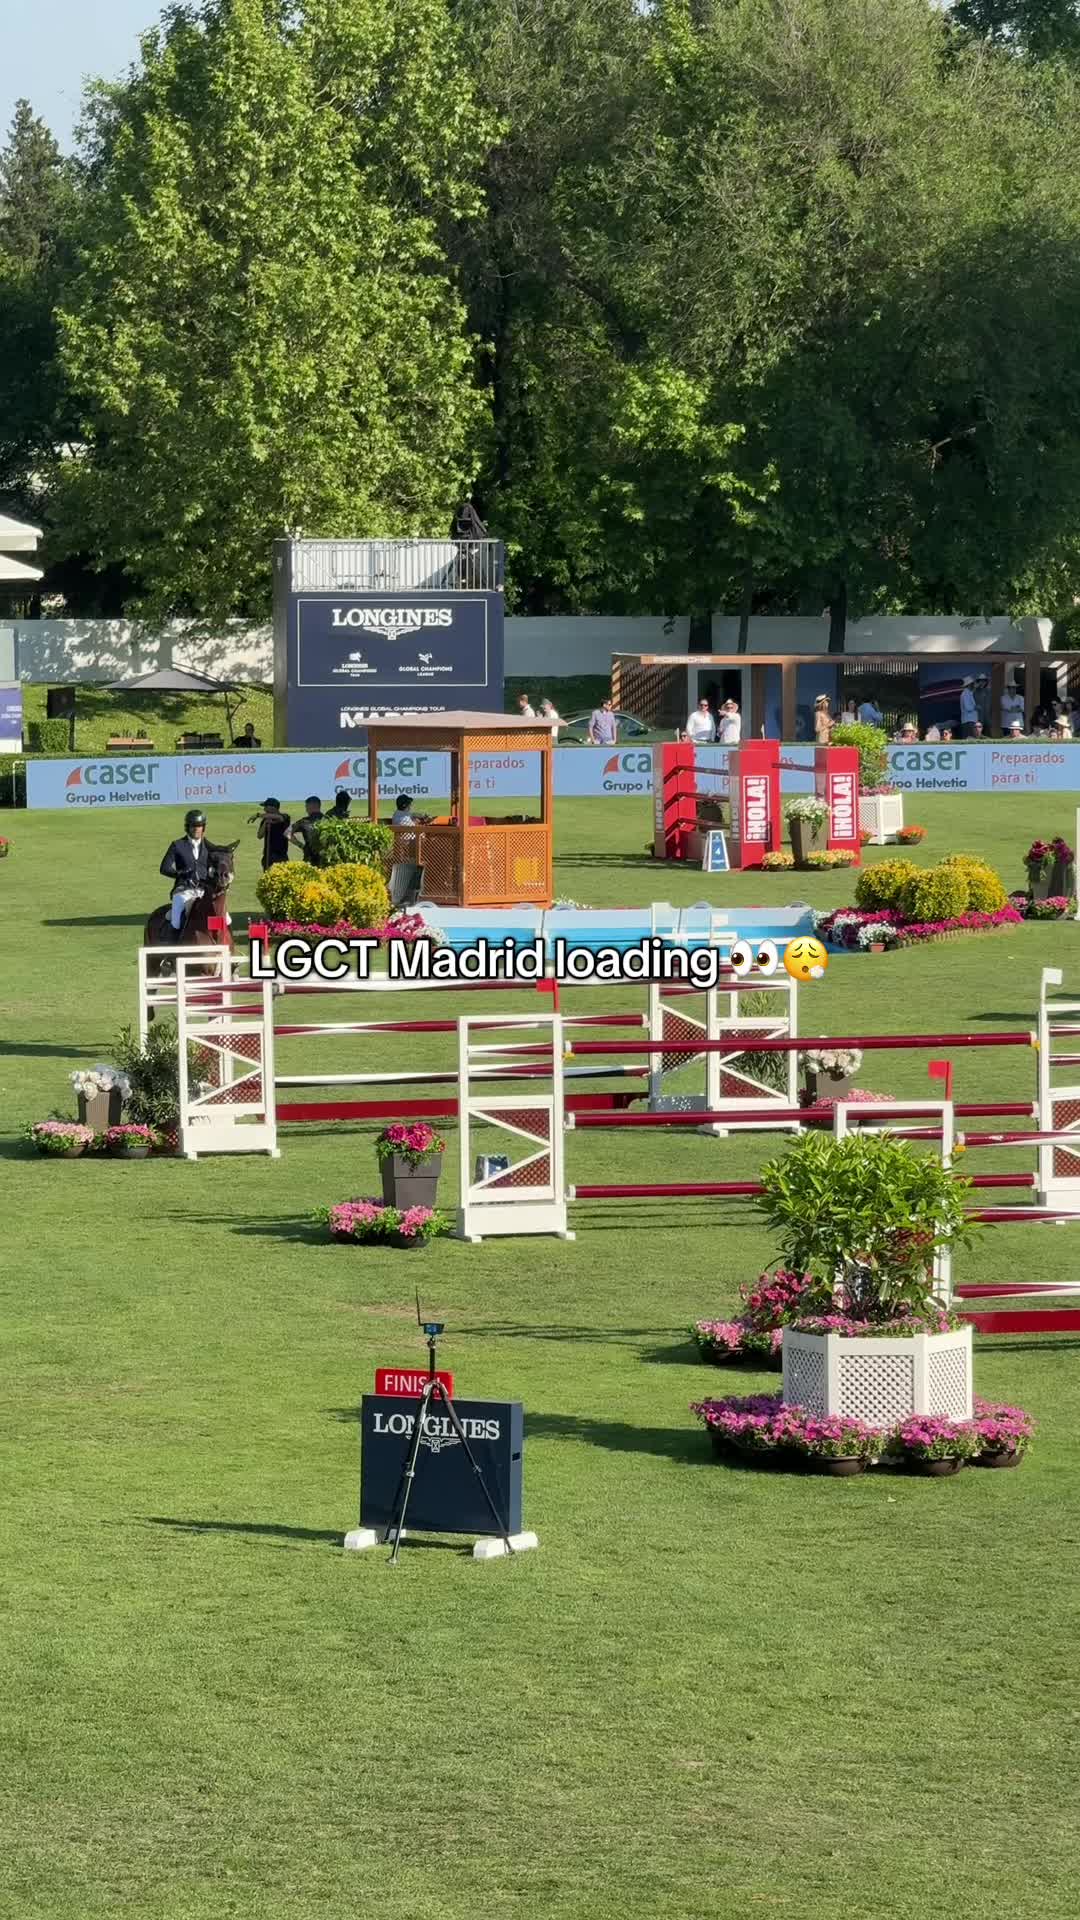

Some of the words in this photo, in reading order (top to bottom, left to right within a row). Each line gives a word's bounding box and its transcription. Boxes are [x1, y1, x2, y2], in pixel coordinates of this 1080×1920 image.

[332, 608, 453, 627] LONGINES
[891, 751, 967, 771] caser
[991, 751, 1065, 766] Preparados
[84, 763, 160, 786] caser
[184, 761, 257, 778] Preparados
[485, 776, 496, 789] ti
[602, 779, 643, 793] Grupo
[916, 777, 968, 788] Helvetia
[991, 774, 1020, 785] para
[1024, 771, 1036, 784] ti
[66, 791, 106, 805] Grupo
[109, 789, 161, 803] Helvetia
[184, 785, 213, 799] para
[217, 783, 228, 795] ti
[377, 783, 429, 796] Helvetia
[746, 777, 767, 841] ¡HOLA!
[832, 775, 853, 838] ¡HOLA!
